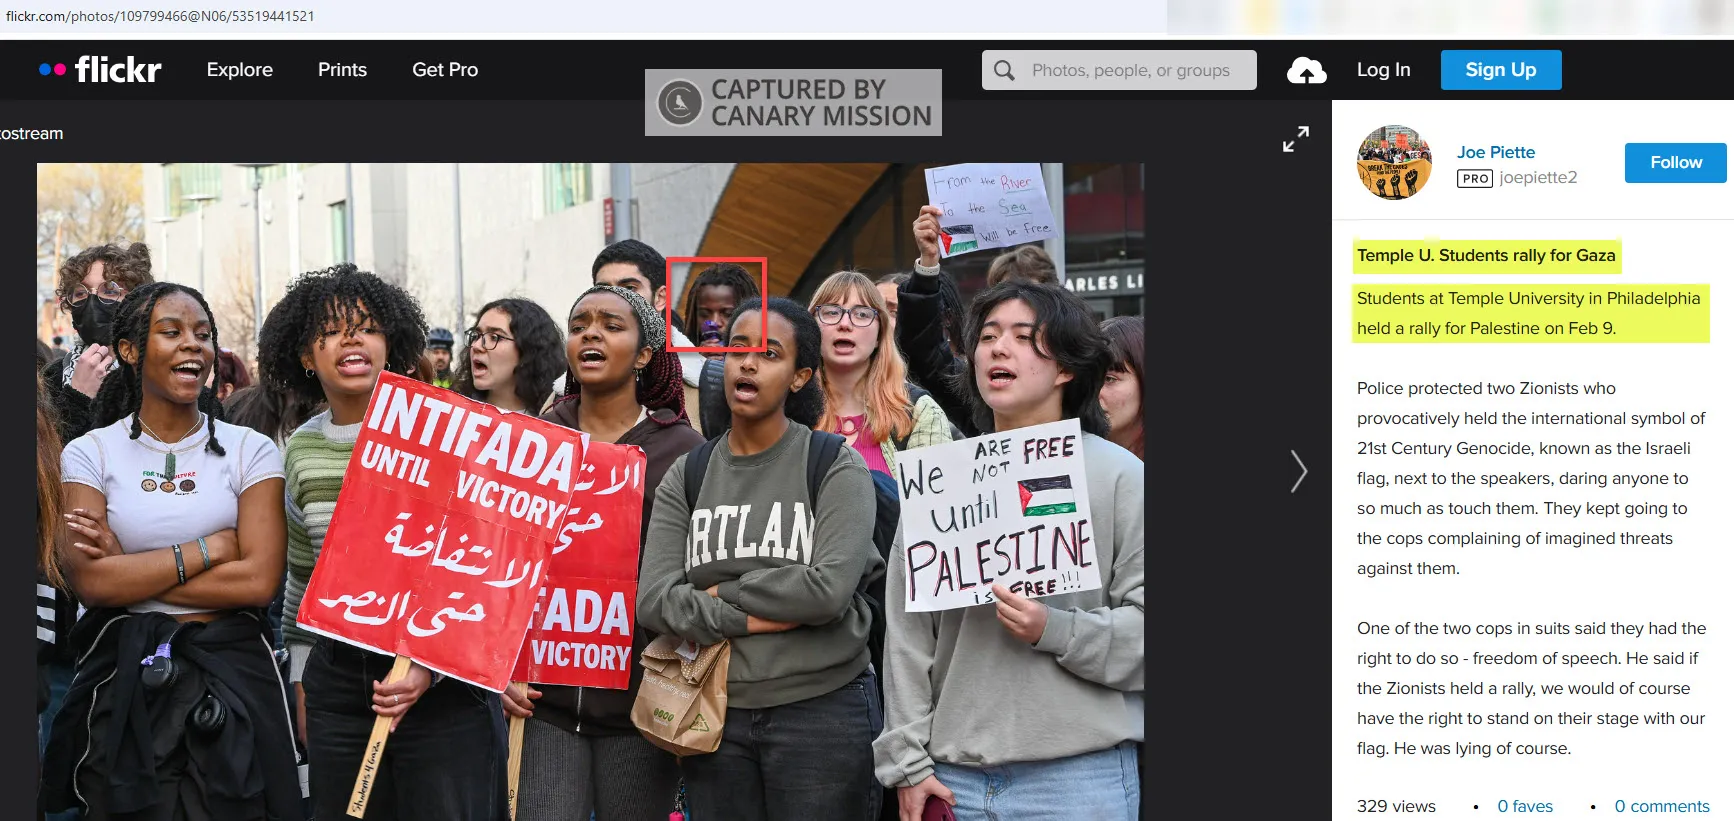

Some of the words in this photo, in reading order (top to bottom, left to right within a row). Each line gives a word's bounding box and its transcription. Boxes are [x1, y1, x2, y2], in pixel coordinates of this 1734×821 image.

[6, 10, 314, 25] flickr.com/photos/109799466@N06/53519441521
[75, 55, 162, 83] flickr
[207, 61, 273, 80] Explore
[319, 61, 367, 77] Prints
[413, 61, 444, 77] Get
[450, 61, 478, 77] Pro
[1033, 63, 1089, 79] Photos,
[1095, 63, 1150, 80] people,
[1157, 66, 1170, 77] or
[1178, 66, 1230, 80] groups
[1358, 61, 1389, 80] Log
[1396, 61, 1410, 77] In
[1466, 61, 1505, 80] Sign
[1512, 61, 1537, 80] Up
[1456, 145, 1486, 159] Joe
[1491, 145, 1535, 159] Piette
[1651, 155, 1703, 169] Follow
[932, 169, 971, 194] From
[980, 177, 995, 187] the
[1000, 174, 1032, 190] River
[1463, 173, 1489, 184] PRO
[1499, 170, 1577, 187] joepiette2
[940, 202, 954, 217] To
[968, 202, 986, 214] the
[998, 199, 1027, 213] Sea
[1006, 227, 1019, 237] be
[1357, 248, 1414, 266] Temple
[1420, 248, 1434, 262] U.
[1440, 248, 1508, 262] Students
[1514, 248, 1546, 266] rally
[1550, 248, 1572, 262] for
[1577, 248, 1615, 262] Gaza
[1358, 291, 1424, 305] Students
[1430, 292, 1444, 305] at
[1448, 291, 1504, 309] Temple
[1509, 291, 1584, 309] University
[1590, 291, 1601, 305] in
[1608, 291, 1700, 309] Philadelphia
[1358, 321, 1390, 335] held
[1396, 324, 1404, 335] a
[1410, 321, 1441, 339] rally
[1445, 321, 1466, 335] for
[1471, 321, 1540, 335] Palestine
[1545, 323, 1564, 335] on
[1569, 321, 1598, 335] Feb
[1603, 321, 1616, 335] 9.
[1358, 381, 1403, 395] Police
[1408, 381, 1482, 399] protected
[1487, 382, 1515, 395] two
[1520, 381, 1578, 395] Zionists
[1583, 381, 1616, 395] who
[1358, 411, 1460, 429] provocatively
[1465, 411, 1497, 425] held
[1502, 411, 1526, 425] the
[1532, 411, 1625, 425] international
[1631, 411, 1685, 429] symbol
[1690, 411, 1706, 425] of
[367, 384, 575, 493] INTIFADA
[974, 438, 1012, 461] ARE
[1024, 435, 1076, 465] FREE
[1358, 441, 1387, 455] 21st
[1392, 441, 1452, 459] Century
[1456, 441, 1534, 457] Genocide,
[1540, 441, 1589, 455] known
[1595, 444, 1612, 455] as
[1616, 441, 1641, 455] the
[1646, 441, 1690, 455] Israeli
[174, 471, 197, 479] ULTURE
[899, 459, 944, 500] We
[972, 461, 1010, 484] NOT
[1357, 471, 1389, 489] flag,
[1395, 472, 1427, 485] next
[1431, 472, 1446, 485] to
[1451, 471, 1475, 485] the
[1481, 471, 1554, 489] speakers,
[1559, 471, 1607, 489] daring
[1612, 474, 1669, 489] anyone
[1673, 472, 1688, 485] to
[360, 440, 430, 488] UNTIL
[456, 470, 567, 529] VICTORY
[685, 501, 815, 573] RTLAN
[907, 519, 1092, 602] PALESTINE
[1358, 561, 1413, 579] against
[1417, 561, 1459, 575] them.
[317, 589, 411, 626] النصر
[974, 592, 994, 605] is
[406, 590, 486, 638] حتى
[1358, 621, 1390, 635] One
[1395, 621, 1411, 635] of
[1414, 621, 1438, 635] the
[1443, 622, 1471, 635] two
[1476, 624, 1512, 639] cops
[1518, 621, 1530, 635] in
[1536, 621, 1570, 635] suits
[1574, 621, 1605, 635] said
[1610, 621, 1644, 639] they
[1649, 621, 1676, 635] had
[1682, 621, 1706, 635] the
[531, 639, 632, 671] VICTORY
[1357, 681, 1382, 695] the
[1387, 681, 1445, 695] Zionists
[1451, 681, 1483, 695] held
[1489, 684, 1497, 695] a
[1503, 681, 1536, 699] rally,
[1541, 684, 1563, 696] we
[1568, 681, 1614, 695] would
[1619, 681, 1635, 695] of
[1639, 684, 1690, 695] course
[367, 741, 382, 764] Gaza
[1357, 741, 1389, 759] flag.
[1394, 741, 1416, 755] He
[1421, 744, 1450, 755] was
[1456, 741, 1491, 759] lying
[1496, 741, 1512, 755] of
[1516, 744, 1571, 755] course.
[1357, 799, 1387, 813] 329
[1393, 799, 1436, 813] views
[1498, 799, 1508, 813] 0
[1513, 799, 1553, 813] faves
[1615, 799, 1625, 813] 0
[1631, 800, 1711, 813] comments
